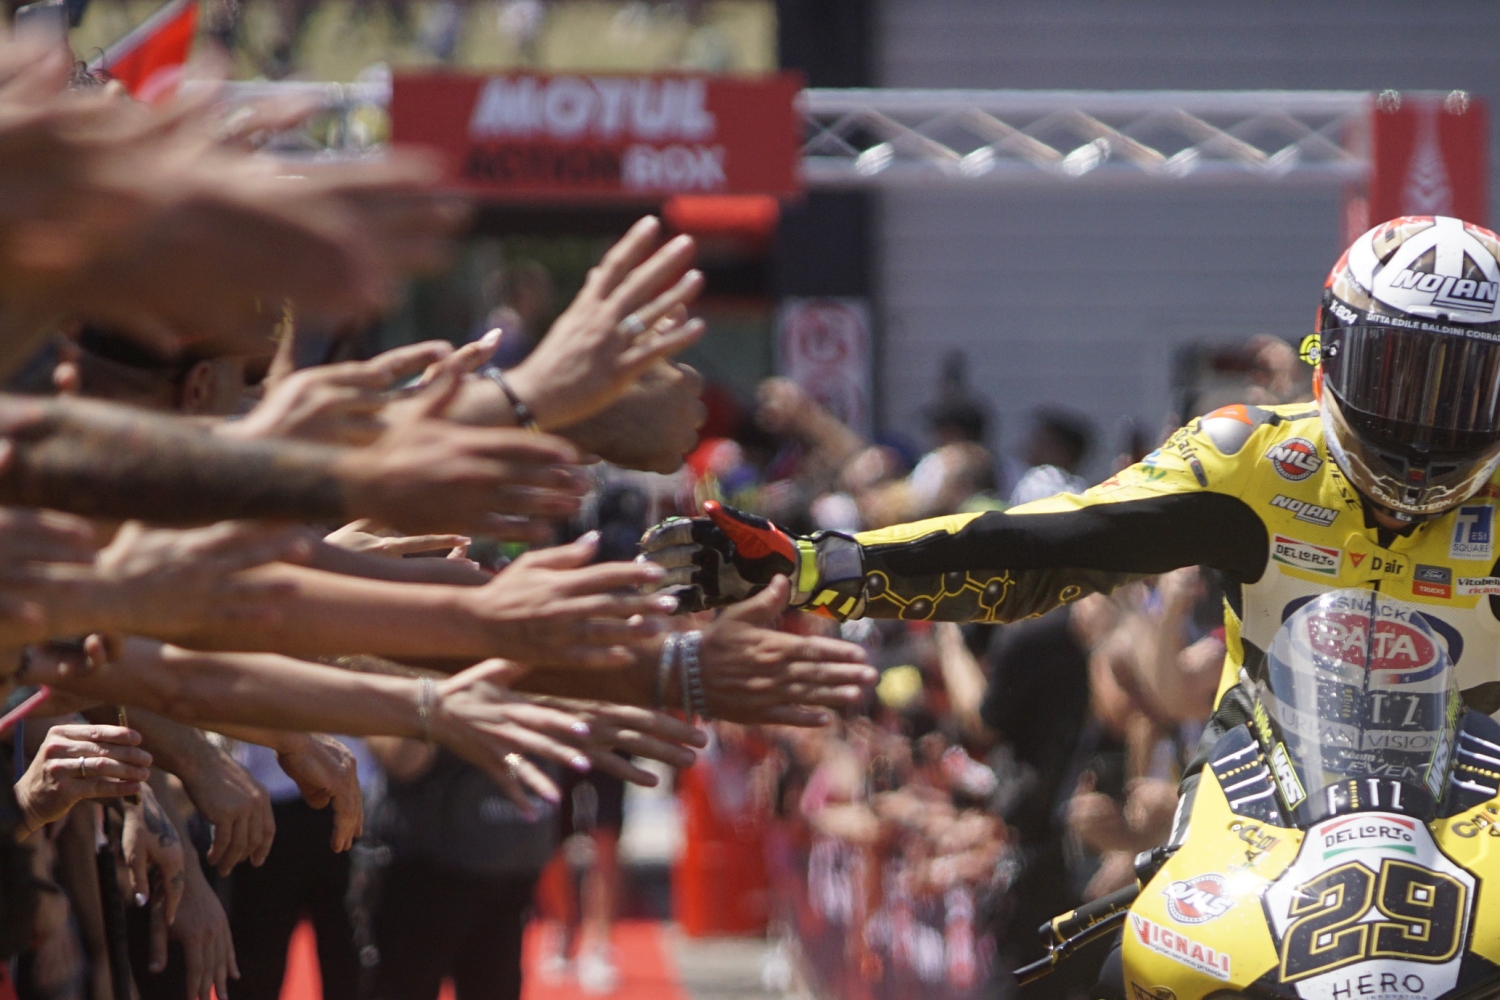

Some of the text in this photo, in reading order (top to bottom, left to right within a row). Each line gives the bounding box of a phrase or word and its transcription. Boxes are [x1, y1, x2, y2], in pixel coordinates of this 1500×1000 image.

[468, 76, 716, 141] MOTUL
[1390, 268, 1499, 314] NOLAN
[1366, 312, 1391, 325] DITTA
[1391, 316, 1420, 330] EDILE
[1421, 321, 1465, 337] BALDINI
[1265, 445, 1324, 474] NILS
[1269, 493, 1340, 528] NOLAN
[1276, 544, 1336, 567] DELLORTO
[1452, 543, 1490, 553] SQUARE
[1421, 567, 1446, 580] Ford
[1418, 584, 1446, 596] TRUCKS
[1318, 619, 1420, 663] PATA
[1325, 824, 1413, 849] DELLORTO
[1279, 858, 1469, 984] 29
[1131, 914, 1229, 973] VIGNALI
